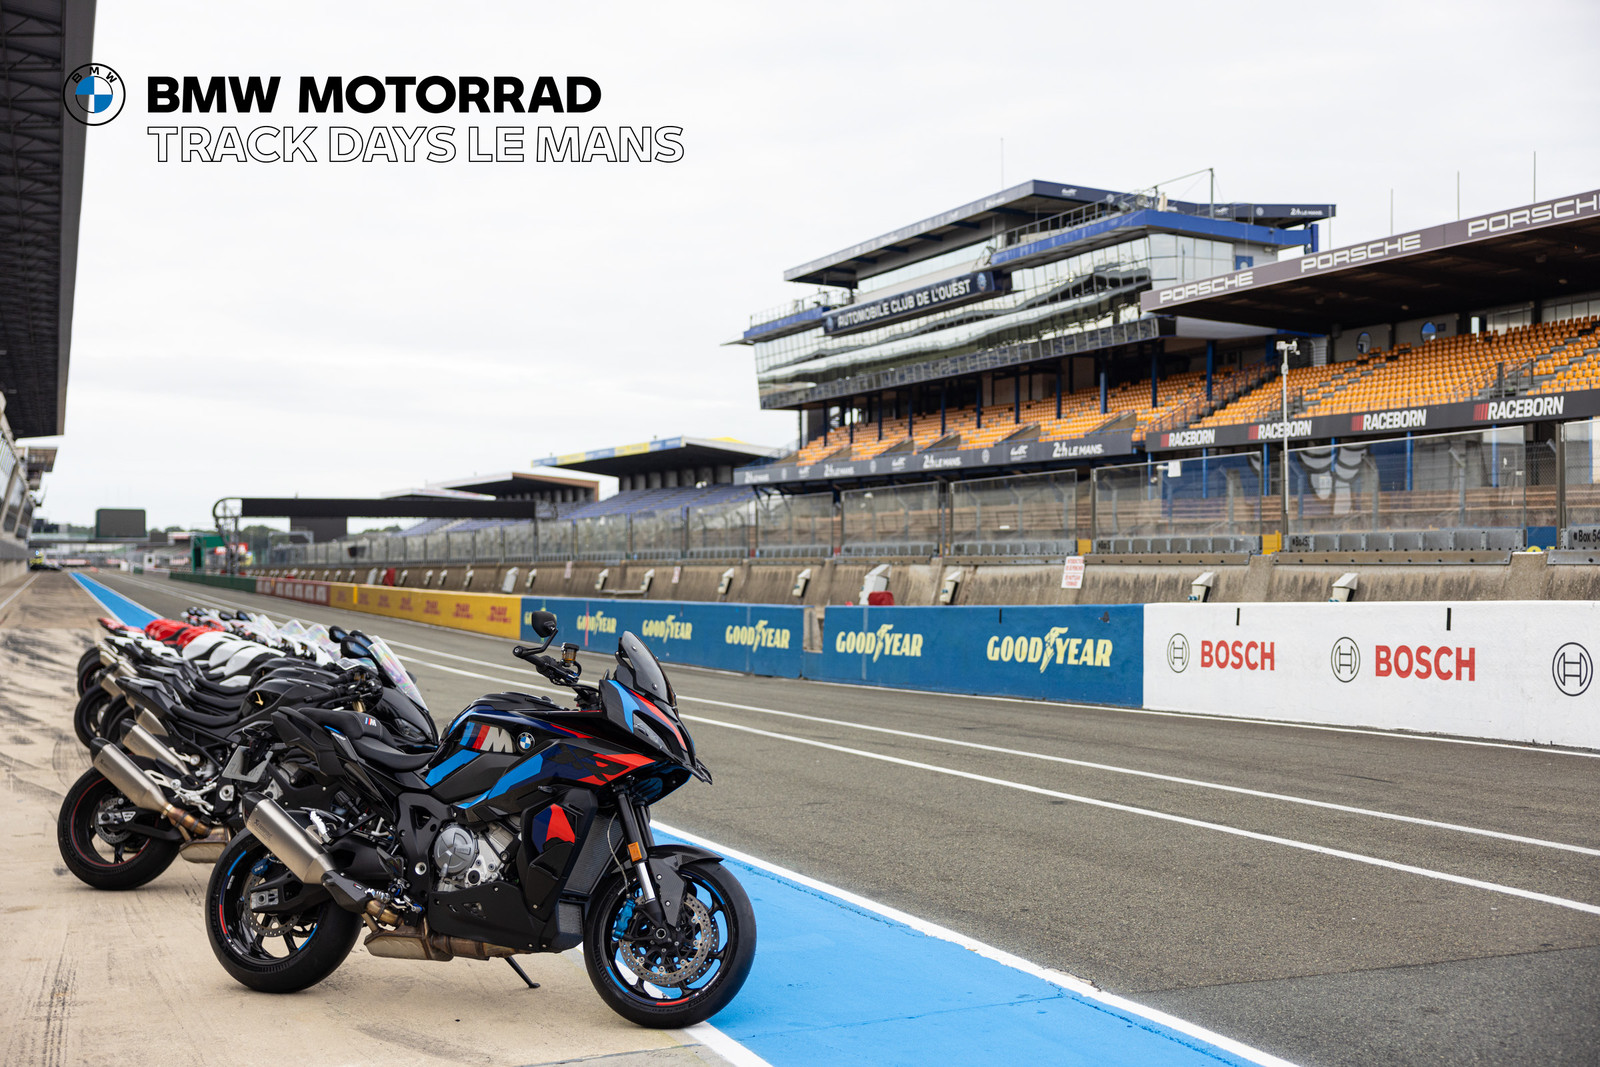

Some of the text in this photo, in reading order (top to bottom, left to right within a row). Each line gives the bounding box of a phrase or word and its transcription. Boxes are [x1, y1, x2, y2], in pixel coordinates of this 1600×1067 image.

[1468, 193, 1600, 237] PORSCH
[1301, 233, 1421, 273] PORSCHE
[1160, 271, 1254, 304] PORSCHE
[837, 279, 971, 328] AUTOMOBILE CLUB DE L'OUEST
[1362, 409, 1428, 431] RACEBORN
[1487, 395, 1564, 420] RACEBORN
[1168, 429, 1215, 447] RACEBORN
[1257, 420, 1312, 440] RACEBORN
[1068, 445, 1078, 456] LE
[1079, 443, 1103, 455] MANS
[1579, 530, 1591, 542] Box
[642, 617, 693, 641] GOODYEAR
[725, 622, 791, 650] GOODYEAR
[835, 628, 924, 659] GOODYEAR
[986, 632, 1113, 669] GOODYEAR
[1201, 640, 1275, 671] BOSCH
[1375, 645, 1476, 681] BOSCH
[480, 726, 514, 753] M
